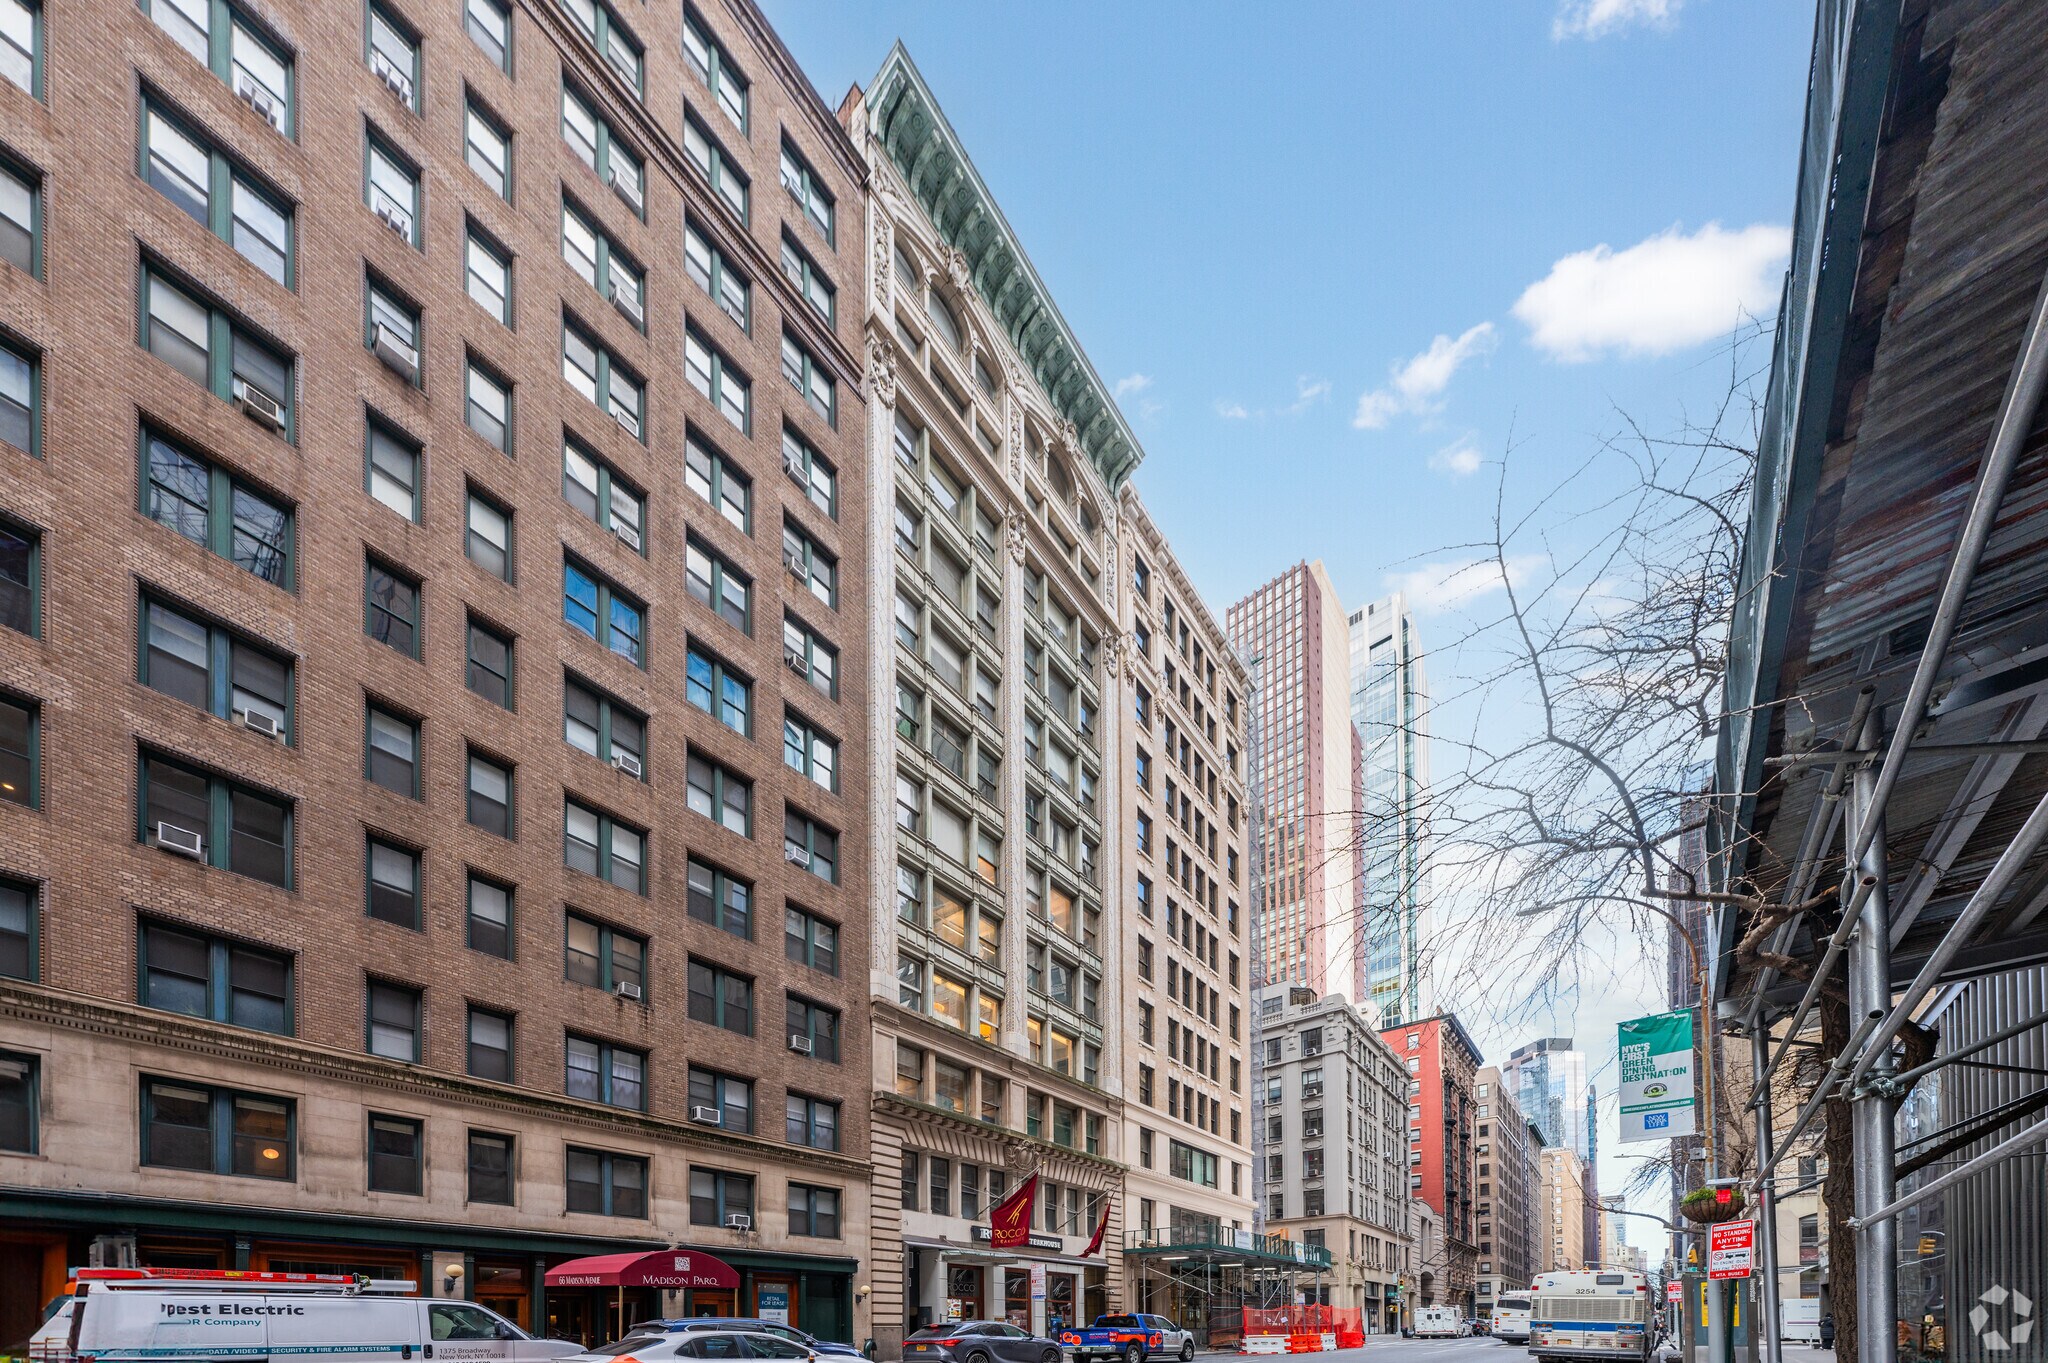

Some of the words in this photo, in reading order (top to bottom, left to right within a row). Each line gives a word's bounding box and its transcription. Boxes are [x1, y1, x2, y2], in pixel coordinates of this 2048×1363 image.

[1621, 1042, 1650, 1054] NYC'S
[1622, 1051, 1649, 1061] FIRST
[1622, 1057, 1653, 1068] GREEN
[1622, 1064, 1656, 1076] DINING
[1622, 1066, 1687, 1083] DESTINATION
[994, 1226, 1026, 1239] ROCCO
[1723, 1228, 1751, 1237] STANDING
[1029, 1238, 1061, 1249] TEAKHOUSE
[1716, 1235, 1748, 1245] ANYTIME
[558, 1275, 566, 1285] 66
[565, 1275, 585, 1285] MADISON
[584, 1275, 601, 1285] AVENUE
[642, 1275, 689, 1285] MADISON
[693, 1275, 720, 1286] PARQ
[218, 1303, 305, 1317] Electric
[204, 1318, 262, 1327] Company
